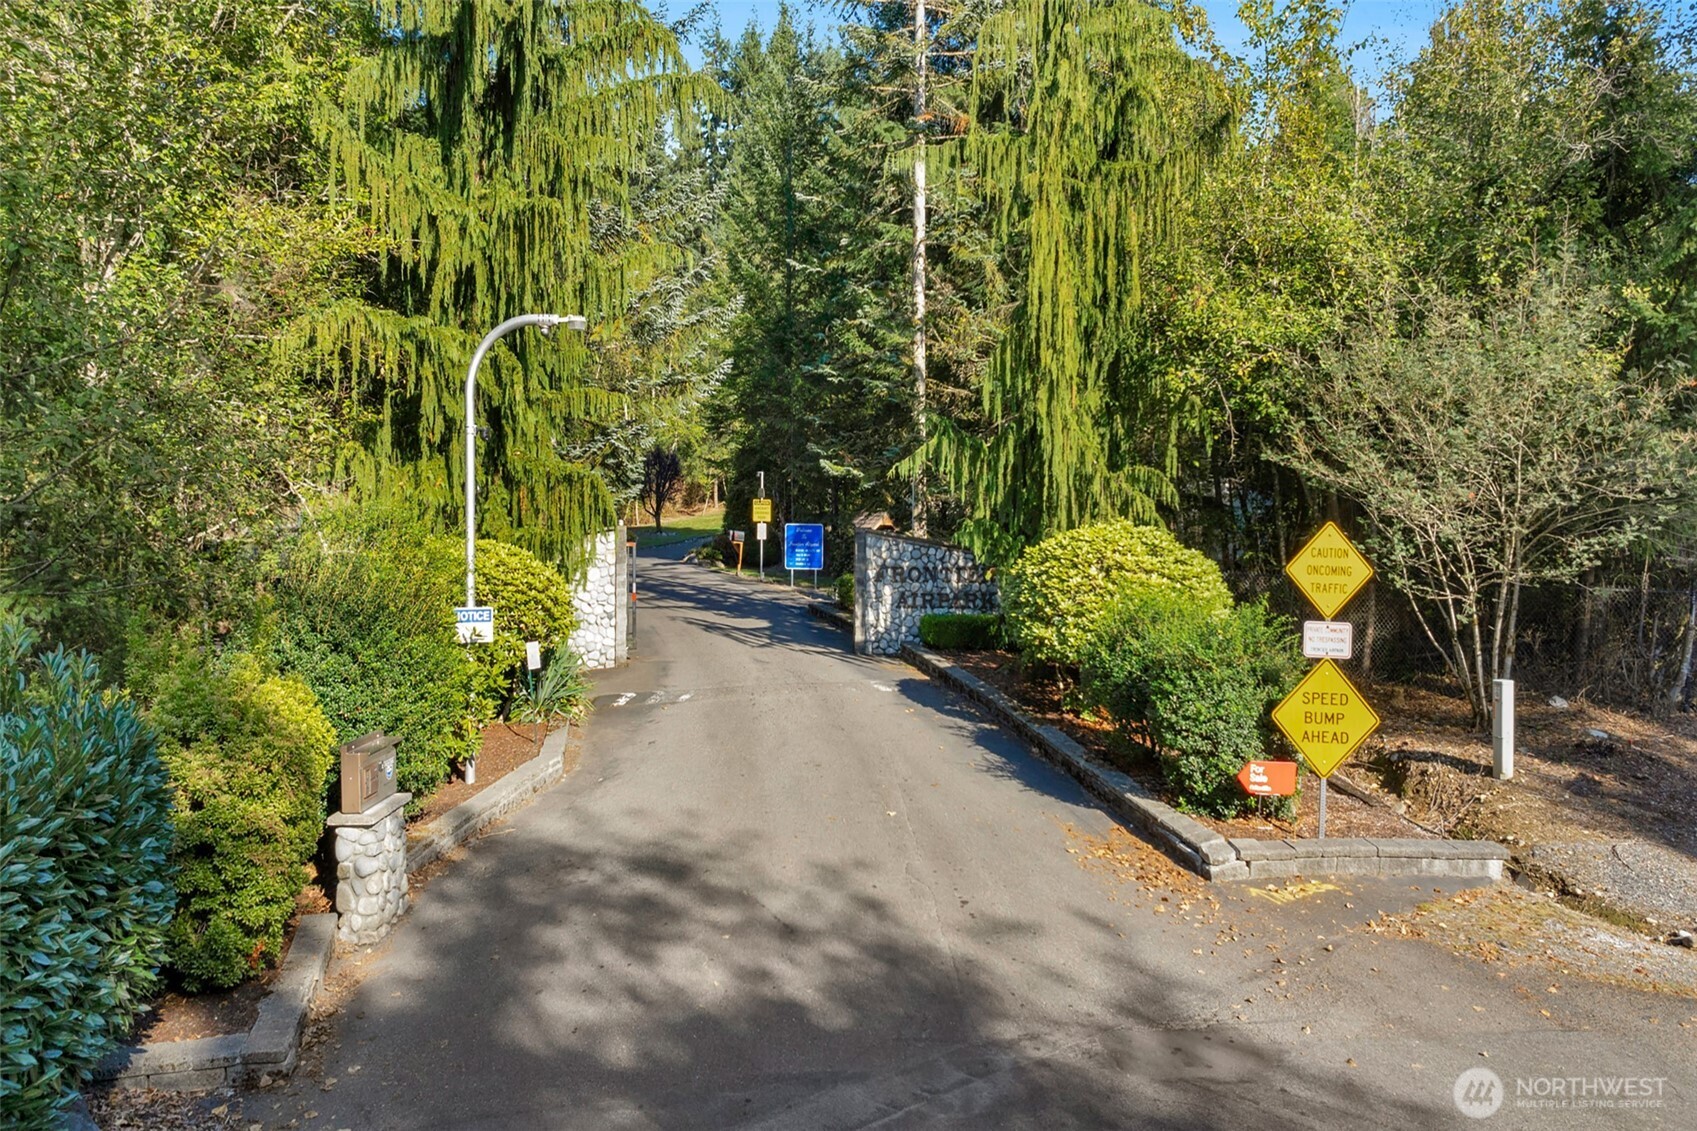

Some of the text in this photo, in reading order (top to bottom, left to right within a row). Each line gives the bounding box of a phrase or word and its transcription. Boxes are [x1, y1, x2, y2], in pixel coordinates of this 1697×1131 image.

[1311, 547, 1349, 558] CAUTION
[1306, 565, 1352, 576] ONCOMING
[1311, 583, 1348, 594] TRAFFIC
[896, 591, 1000, 611] AIRPARK
[1302, 692, 1349, 706] SPEED
[1304, 711, 1345, 725] BUMP
[1301, 730, 1349, 745] AHEAD
[1250, 763, 1265, 773] For
[1249, 773, 1268, 783] Sale
